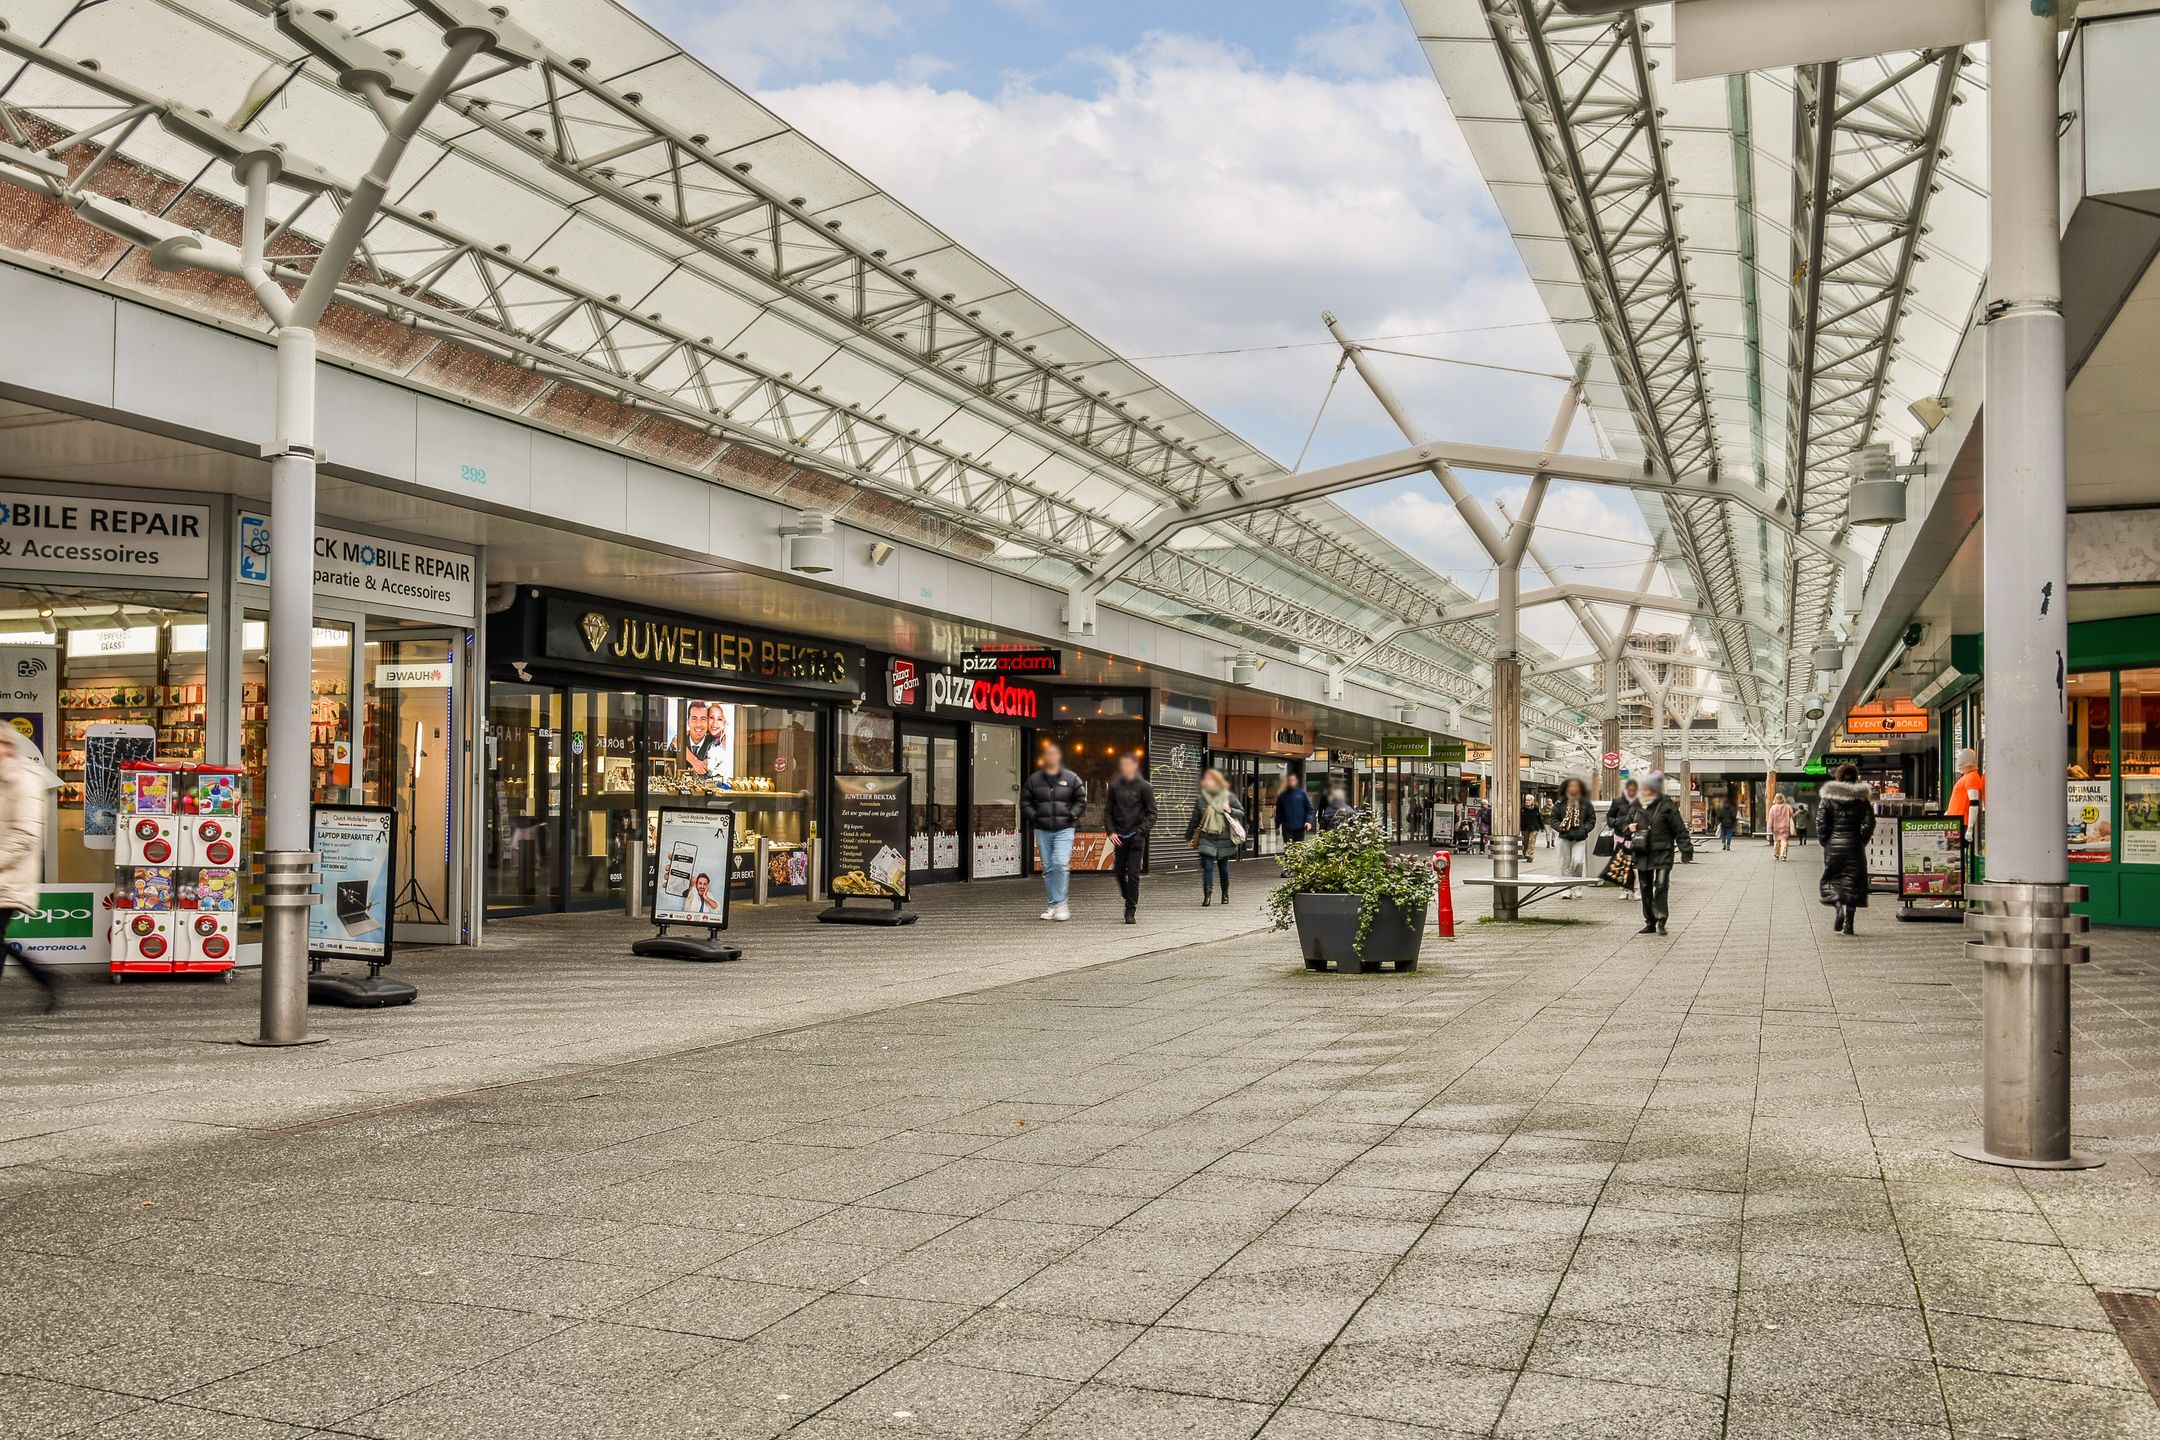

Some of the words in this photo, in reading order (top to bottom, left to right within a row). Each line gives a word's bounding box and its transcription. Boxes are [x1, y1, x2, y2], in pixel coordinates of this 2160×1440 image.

[90, 508, 200, 538] REPAIR
[21, 539, 160, 565] Accessoires
[343, 542, 410, 572] MOBILE
[415, 555, 470, 583] REPAIR
[365, 575, 377, 590] &
[381, 578, 451, 602] Accessoires
[614, 617, 754, 673] JUWELIER
[14, 691, 38, 702] Only
[1849, 721, 1881, 729] LEVENT
[1896, 720, 1924, 728] BÖREK
[1386, 742, 1425, 751] Sprinter
[1825, 758, 1858, 766] DOUGLAS
[1905, 822, 1958, 831] Superdeals
[318, 831, 340, 839] LAPTOP
[341, 832, 374, 841] REPARATIE?
